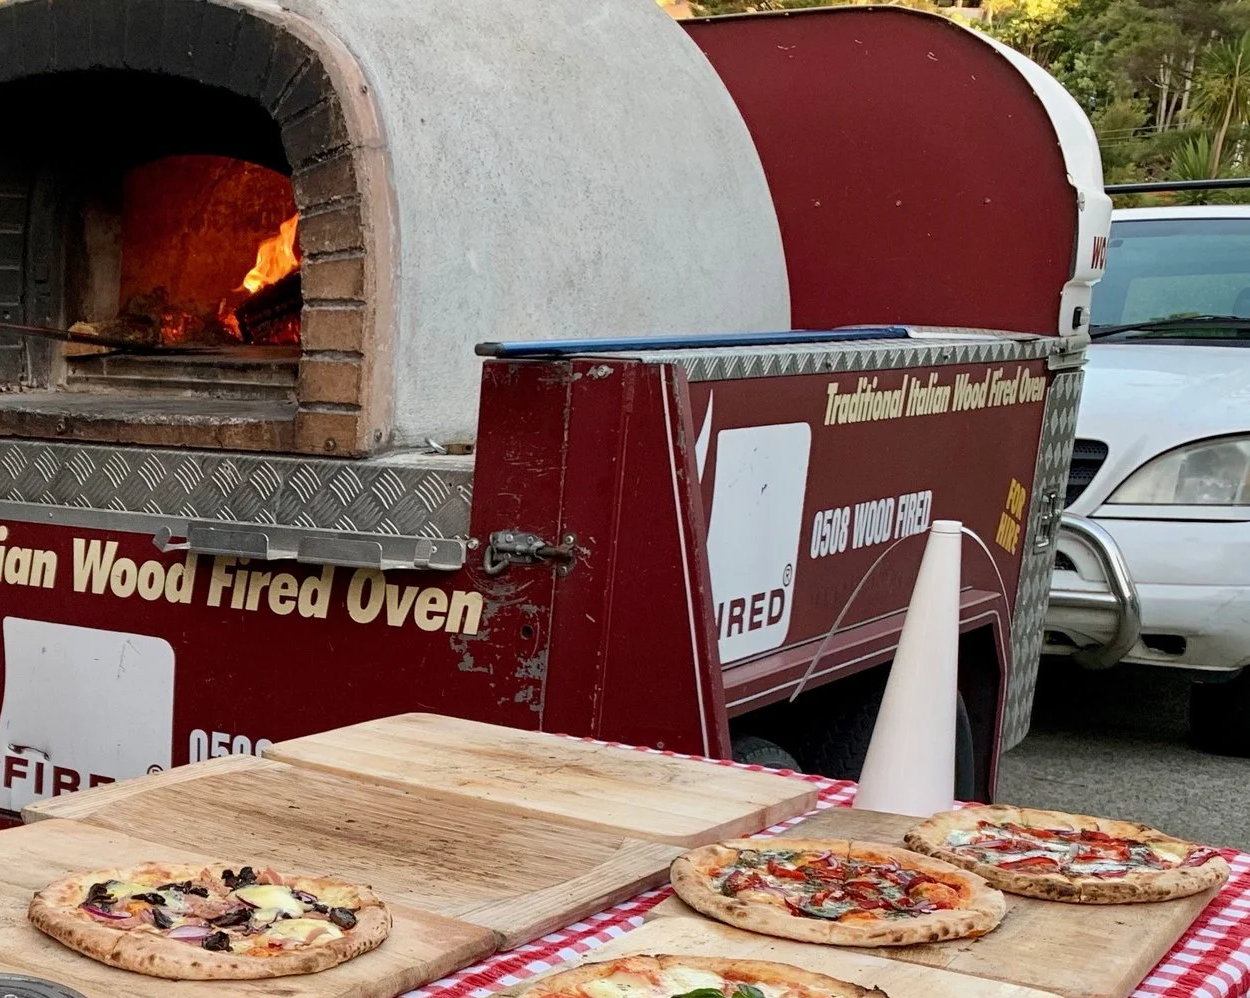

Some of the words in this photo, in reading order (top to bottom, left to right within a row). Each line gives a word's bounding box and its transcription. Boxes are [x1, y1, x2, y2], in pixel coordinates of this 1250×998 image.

[824, 374, 908, 425] Traditional
[906, 372, 951, 417] Italian
[952, 368, 992, 412] Wood
[988, 366, 1022, 407] Fired
[1019, 367, 1047, 403] Oven
[810, 506, 850, 560] 0508
[852, 497, 895, 550] WOOD
[894, 489, 933, 540] FIRED
[1006, 478, 1027, 521] FOR
[995, 511, 1021, 556] HIRE
[73, 537, 198, 605] Wood
[207, 554, 336, 620] Fired
[347, 567, 485, 636] Oven
